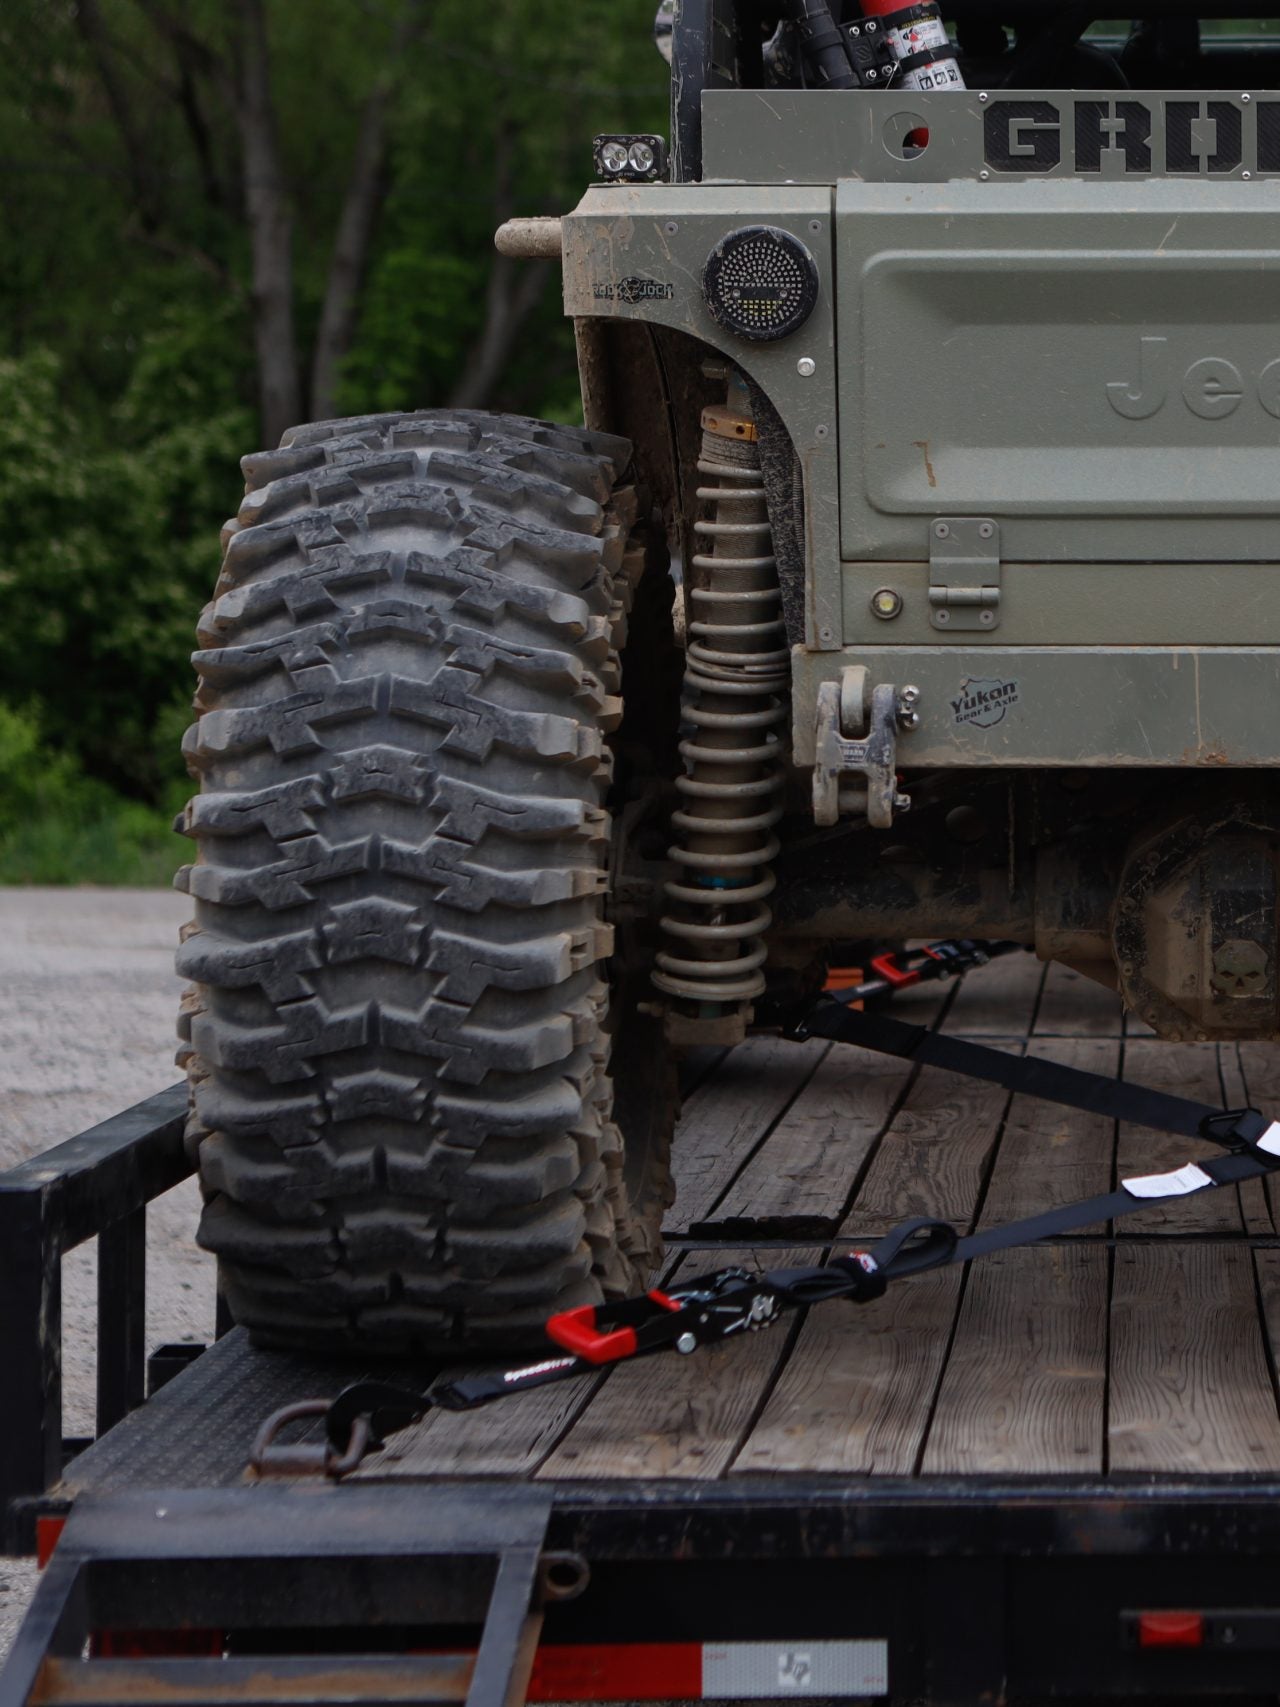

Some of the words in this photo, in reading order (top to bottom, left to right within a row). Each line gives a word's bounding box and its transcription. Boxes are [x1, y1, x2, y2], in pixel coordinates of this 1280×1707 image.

[950, 682, 1016, 714] Yukon
[955, 708, 983, 723] Gear
[993, 695, 1018, 709] Axle
